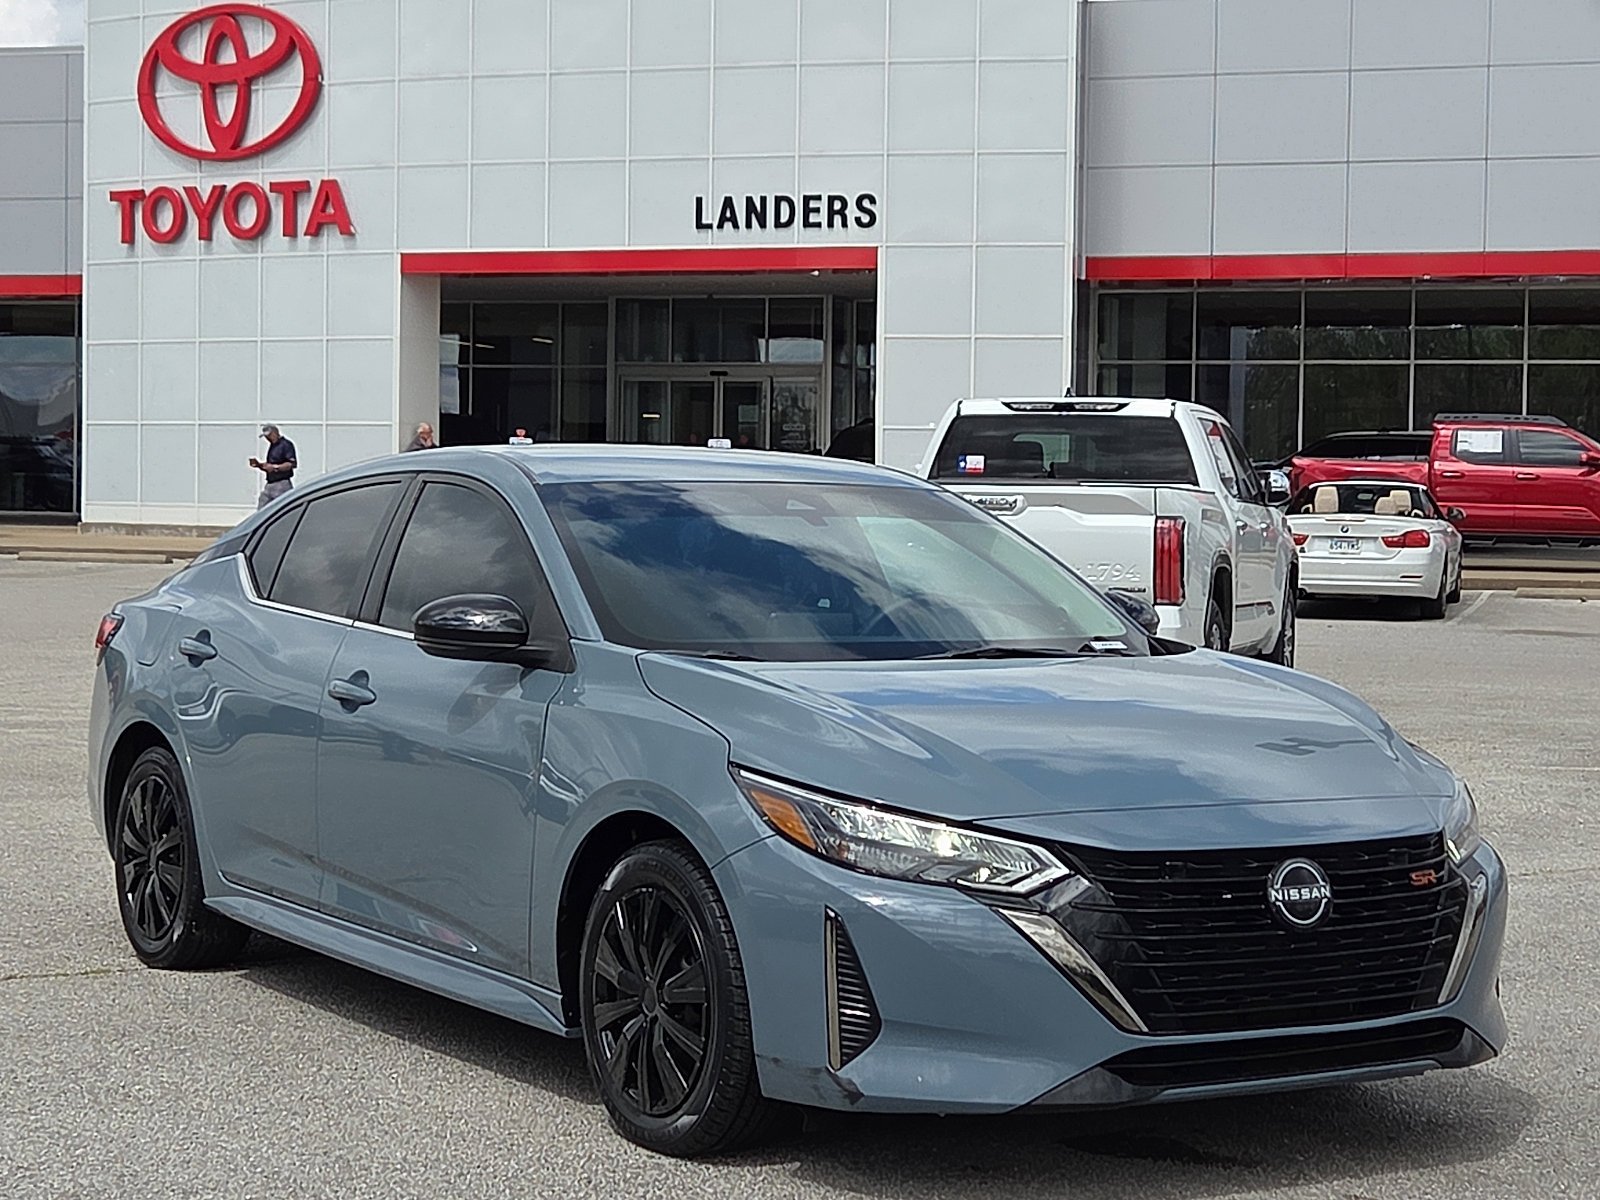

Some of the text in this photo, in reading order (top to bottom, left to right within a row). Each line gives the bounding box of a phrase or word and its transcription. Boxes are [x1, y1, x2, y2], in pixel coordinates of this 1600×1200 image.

[110, 179, 355, 244] TOYOTA
[695, 193, 877, 230] LANDERS
[1086, 563, 1141, 582] 1794
[1410, 869, 1438, 886] SR
[1270, 886, 1331, 902] NISSAN
